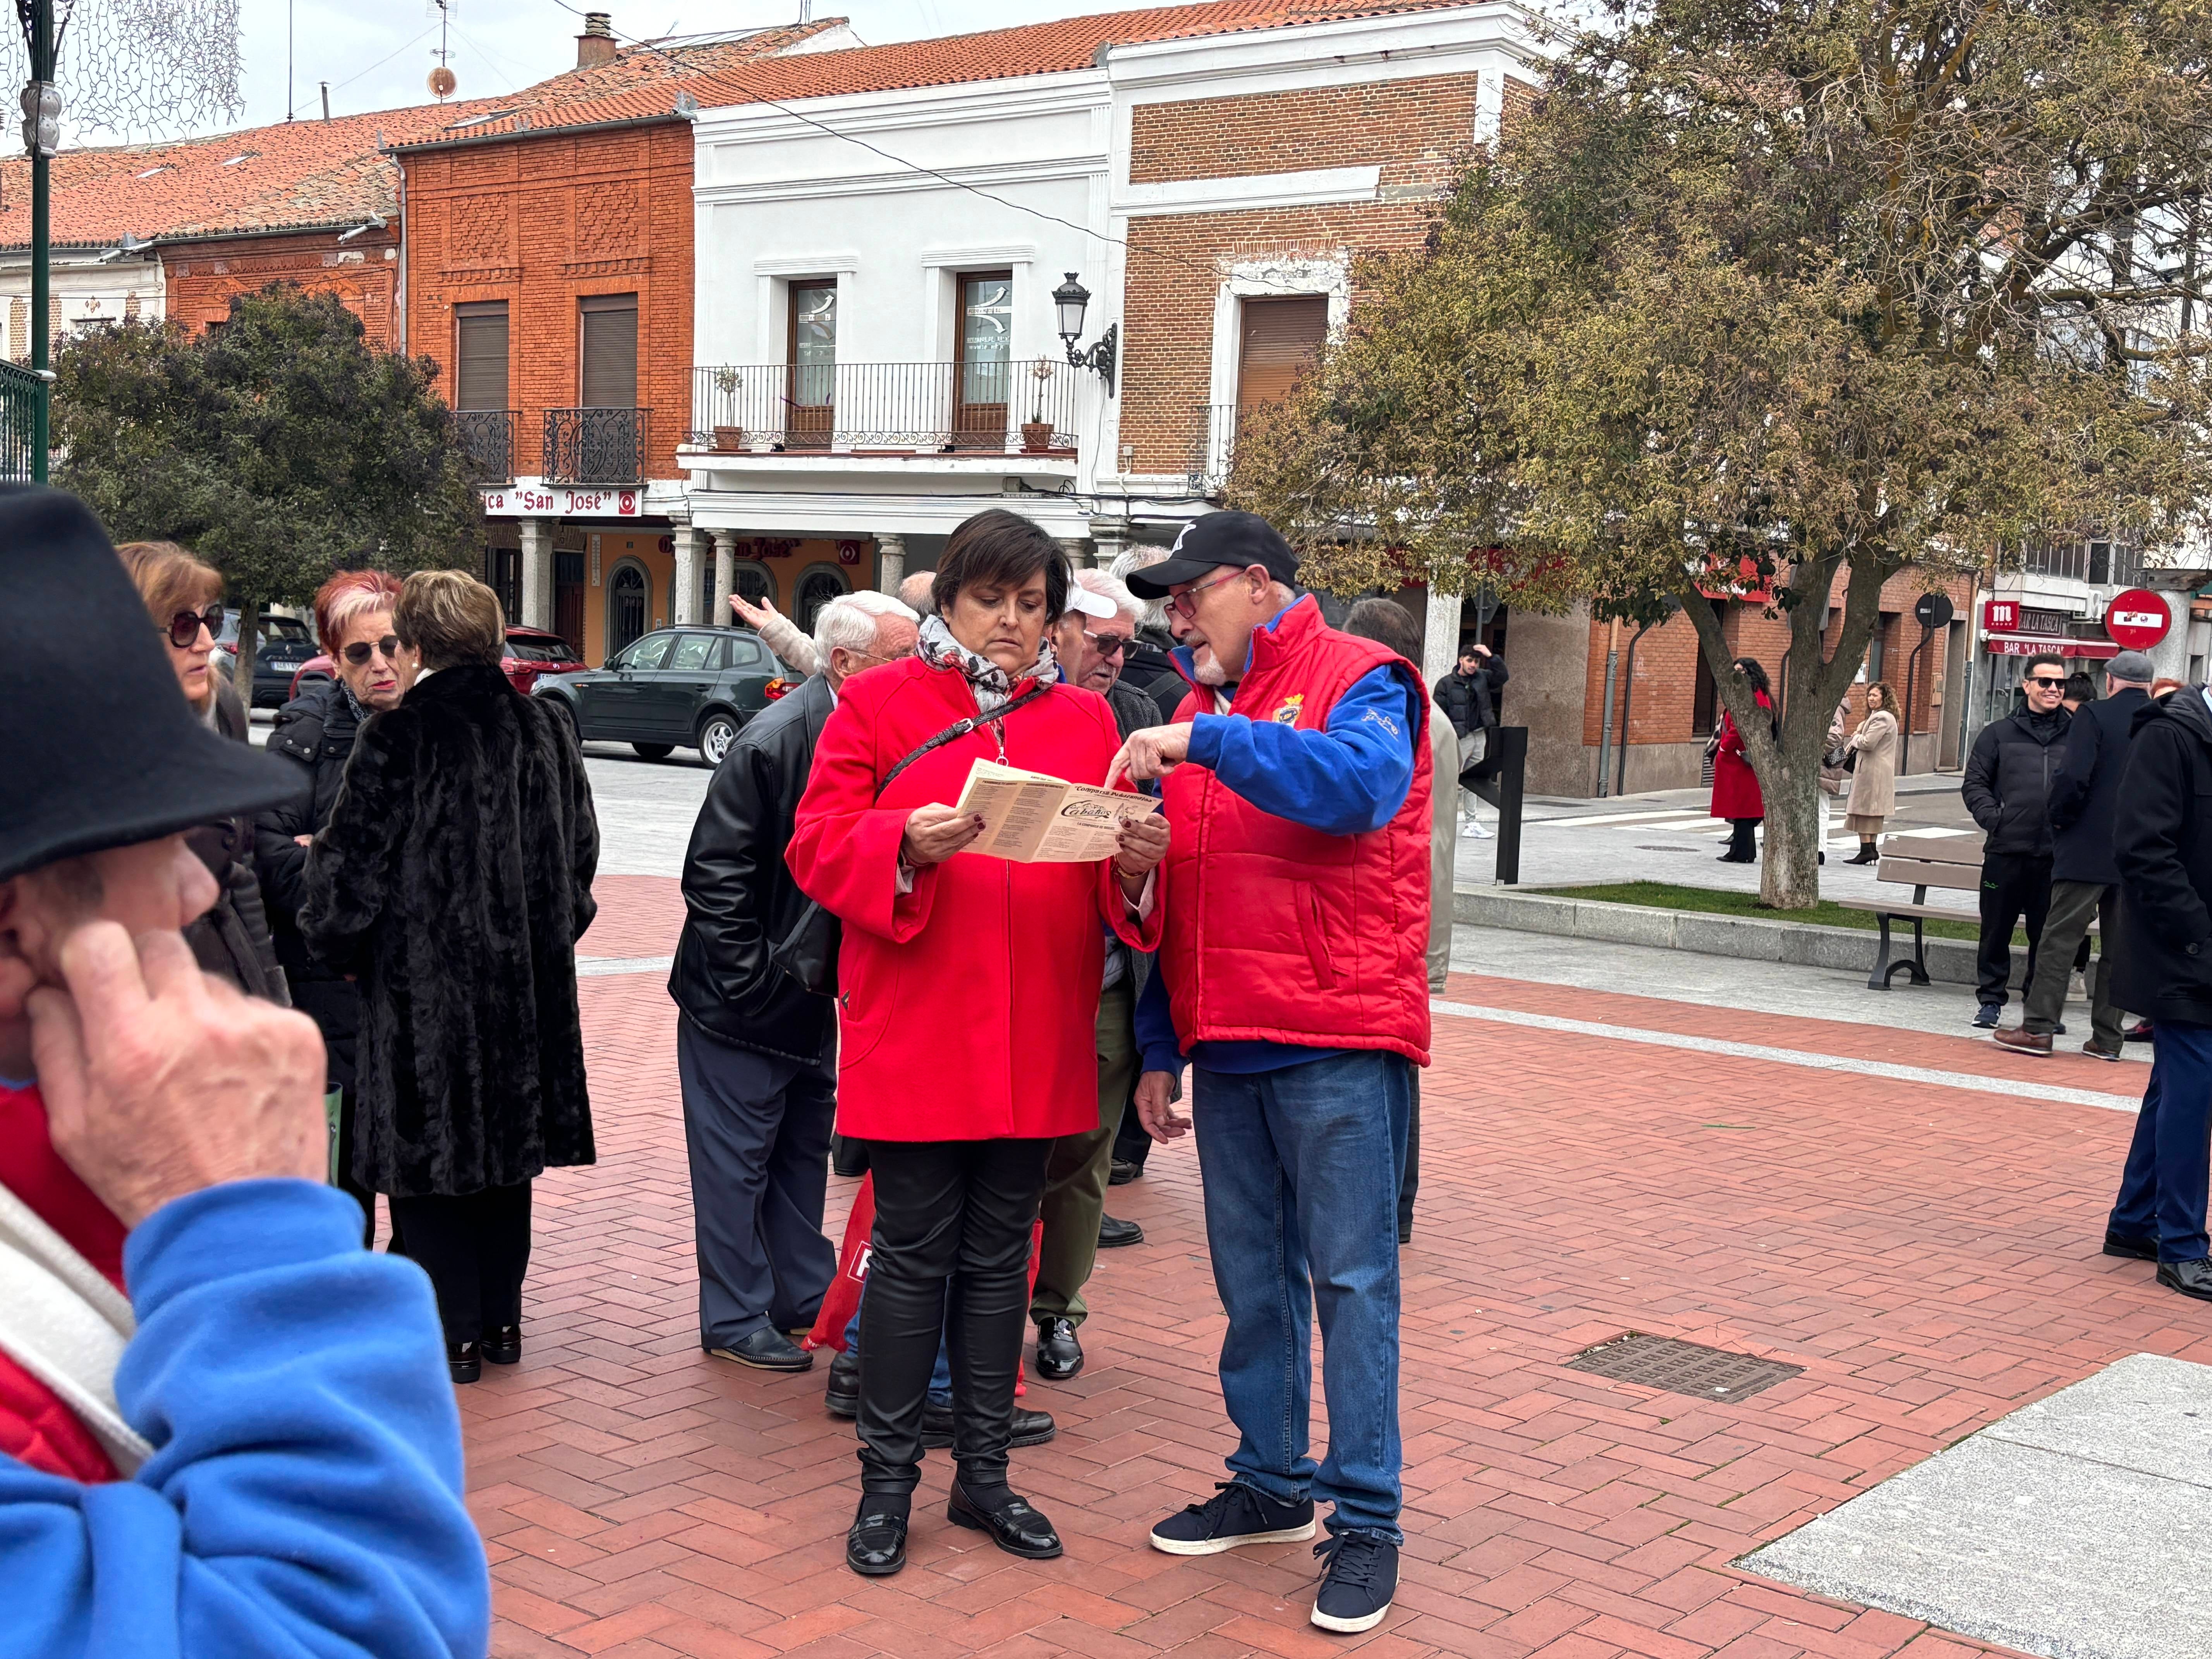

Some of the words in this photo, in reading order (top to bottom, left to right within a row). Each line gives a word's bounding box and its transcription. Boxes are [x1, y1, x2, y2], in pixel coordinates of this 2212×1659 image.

[565, 490, 611, 514] José"
[2018, 613, 2031, 629] BAR
[2031, 613, 2039, 630] LA
[2040, 615, 2059, 632] TASCA
[2004, 642, 2020, 654] BAR
